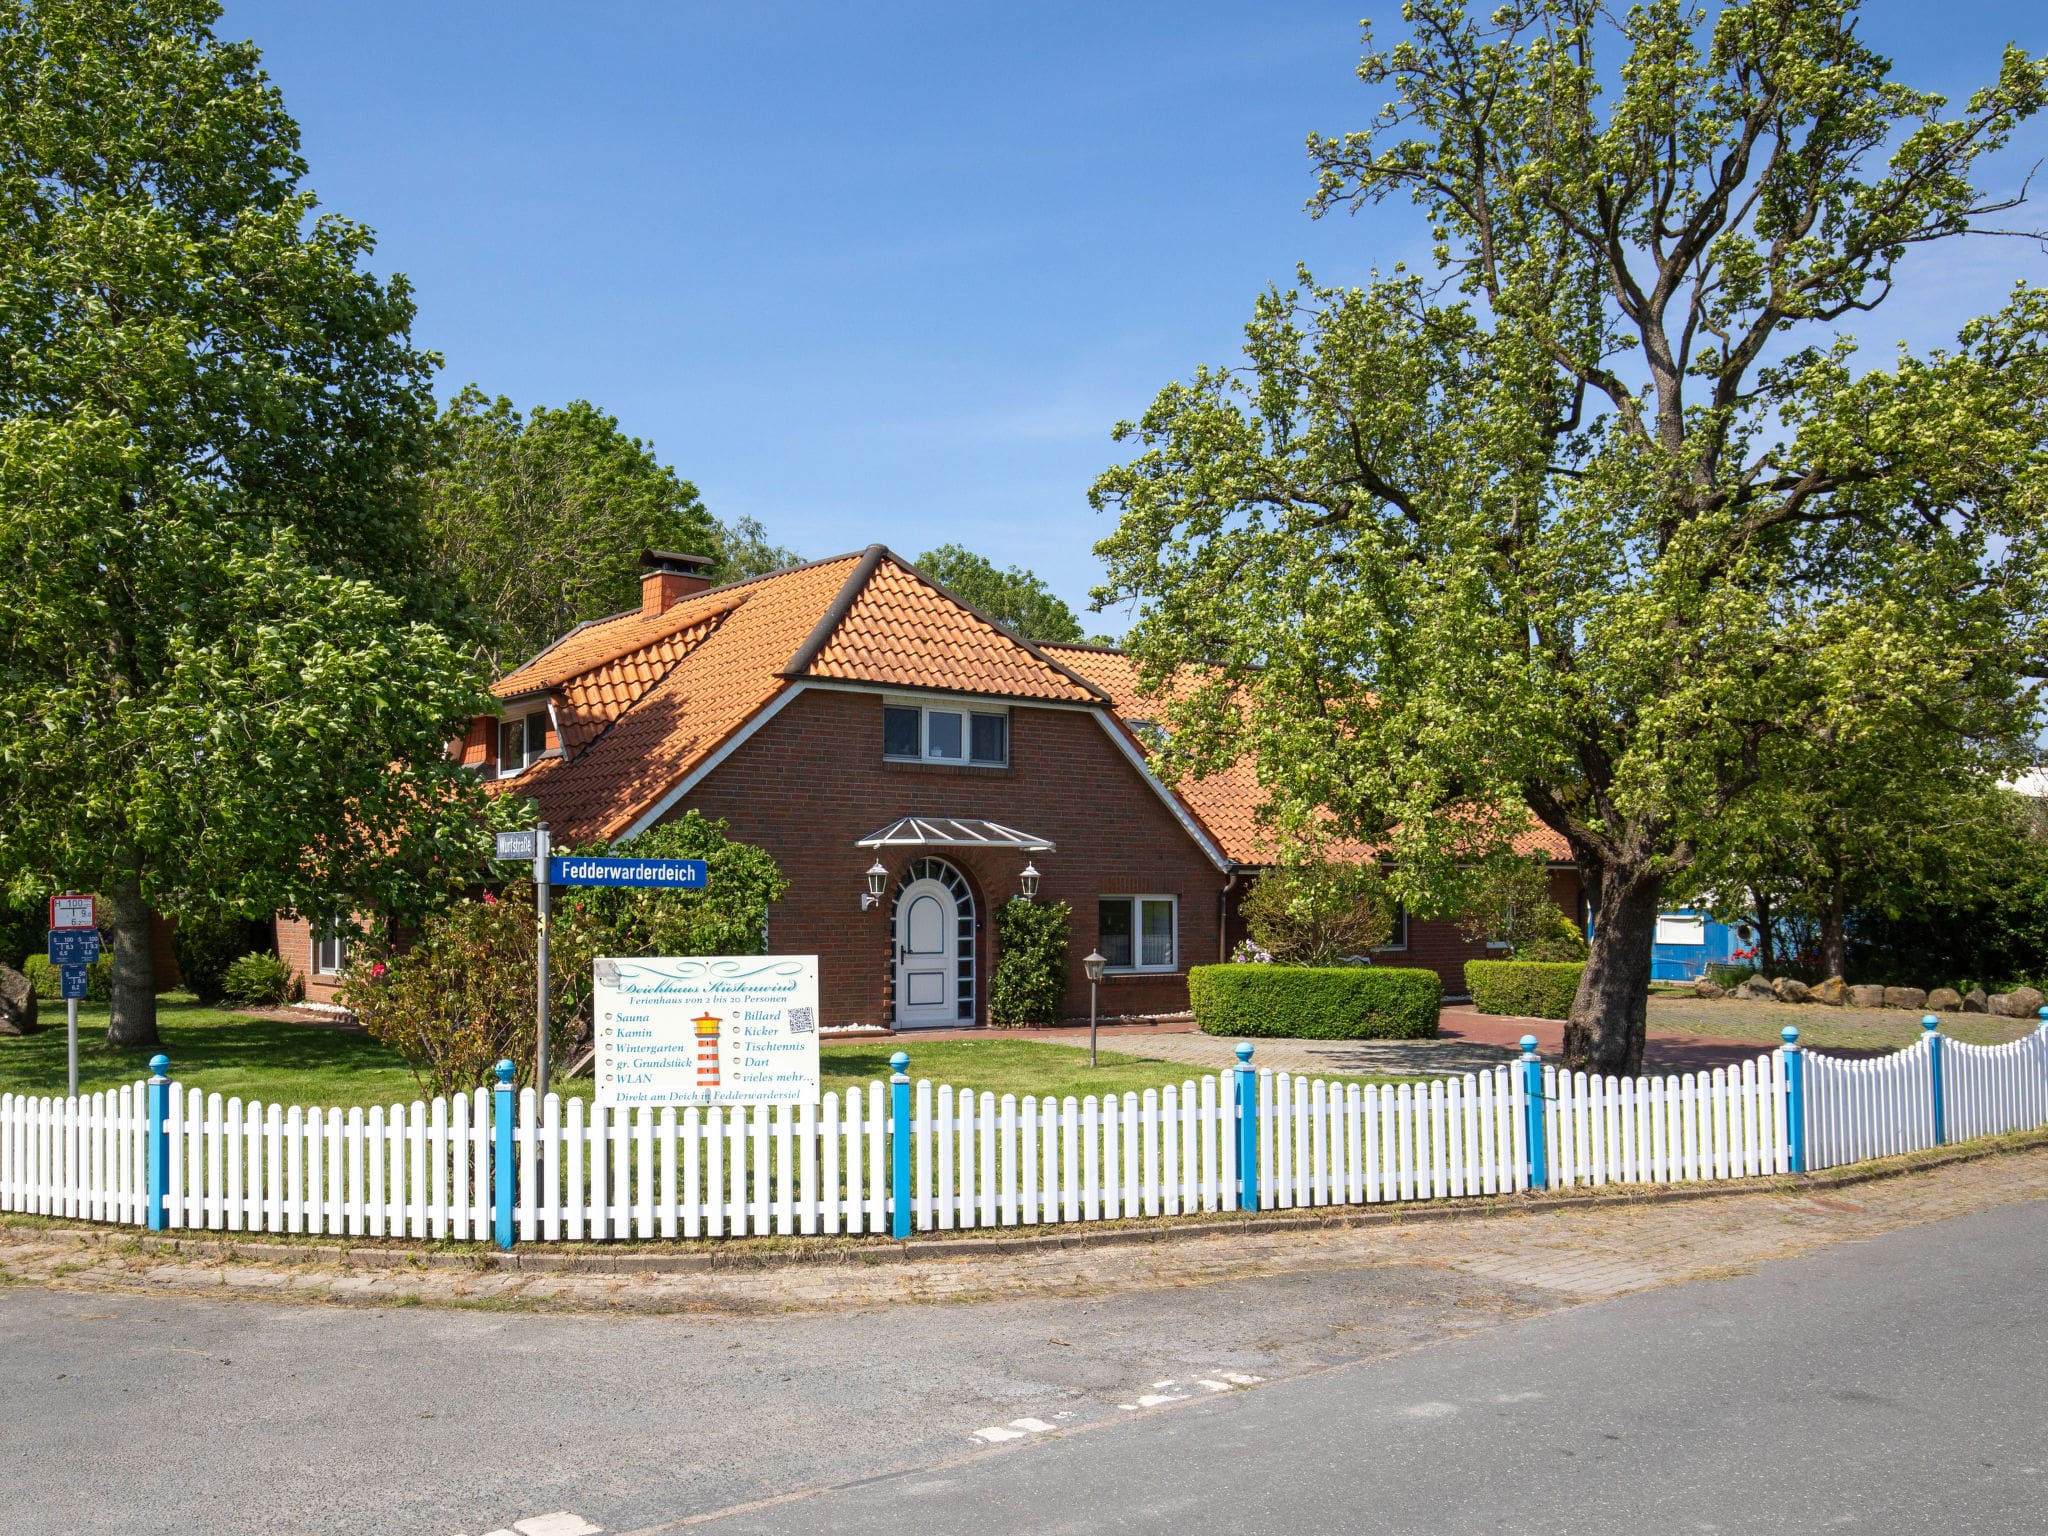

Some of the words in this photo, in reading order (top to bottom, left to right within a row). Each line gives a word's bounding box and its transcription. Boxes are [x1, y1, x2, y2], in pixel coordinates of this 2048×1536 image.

[562, 862, 696, 881] Fedderwarderdeich
[617, 979, 700, 994] Deichhaus
[703, 979, 797, 993] Küstenwind
[629, 996, 682, 1005] Ferienhaus
[713, 995, 727, 1003] bis
[745, 995, 787, 1003] Personen
[616, 1013, 649, 1022] Sauna
[744, 1011, 781, 1021] Billard
[617, 1028, 652, 1037] Kamin
[744, 1026, 779, 1036] Kicker
[616, 1043, 684, 1055] Wintergarten
[745, 1041, 805, 1051] Tischtennis
[616, 1061, 629, 1070] gr.
[633, 1057, 692, 1068] Grundstück
[745, 1057, 769, 1067] Dart
[617, 1074, 653, 1083] WLAN
[743, 1072, 773, 1082] vieles
[616, 1093, 648, 1101] Direkt
[669, 1091, 698, 1101] Deich
[713, 1090, 800, 1099] Fedderwardersiel
